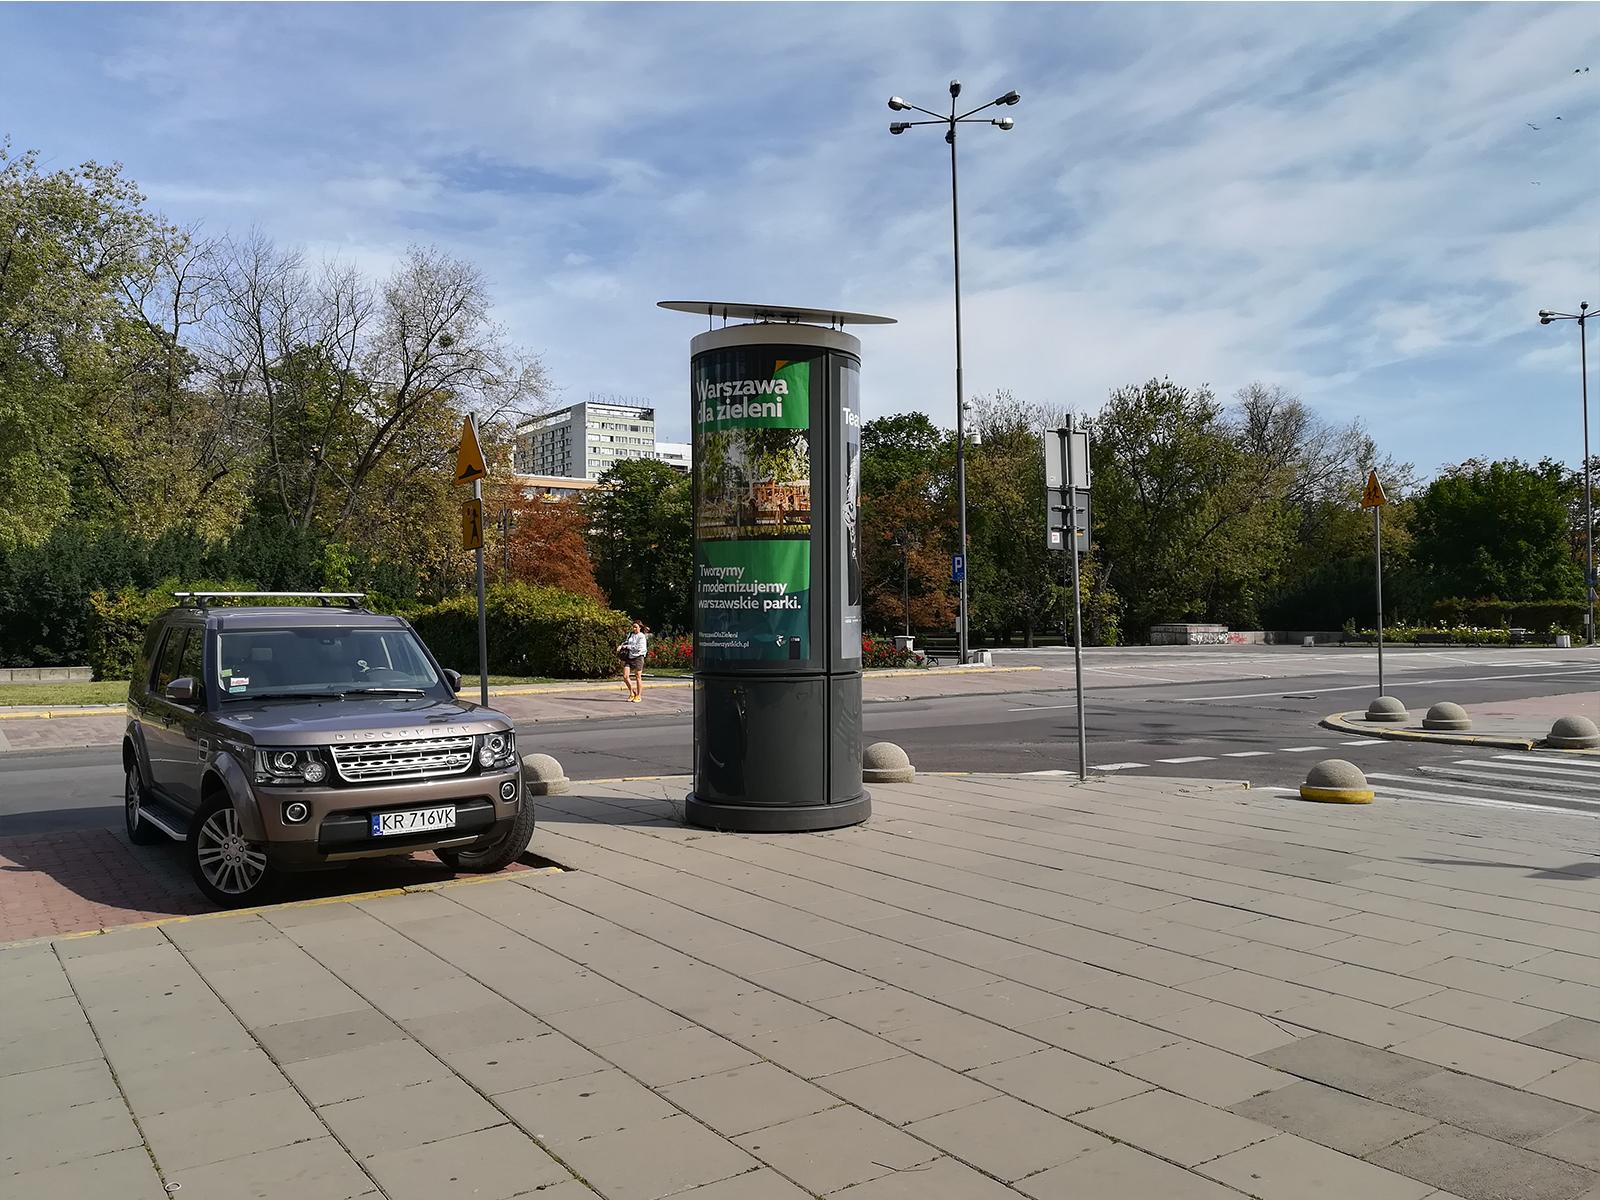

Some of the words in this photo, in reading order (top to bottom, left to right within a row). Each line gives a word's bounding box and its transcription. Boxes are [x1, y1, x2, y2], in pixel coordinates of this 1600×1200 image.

[696, 378, 789, 402] Warszawa
[697, 401, 714, 424] dla
[716, 396, 783, 420] zieleni
[842, 407, 861, 428] Tea
[699, 564, 745, 579] Tworzymy
[955, 556, 962, 573] P
[697, 580, 701, 593] i
[702, 579, 788, 596] modernizujemy
[698, 595, 760, 609] warszawskie
[763, 595, 802, 612] parki.
[335, 725, 471, 741] DISCOVERY
[382, 814, 405, 830] KR
[410, 808, 453, 828] 716VK
